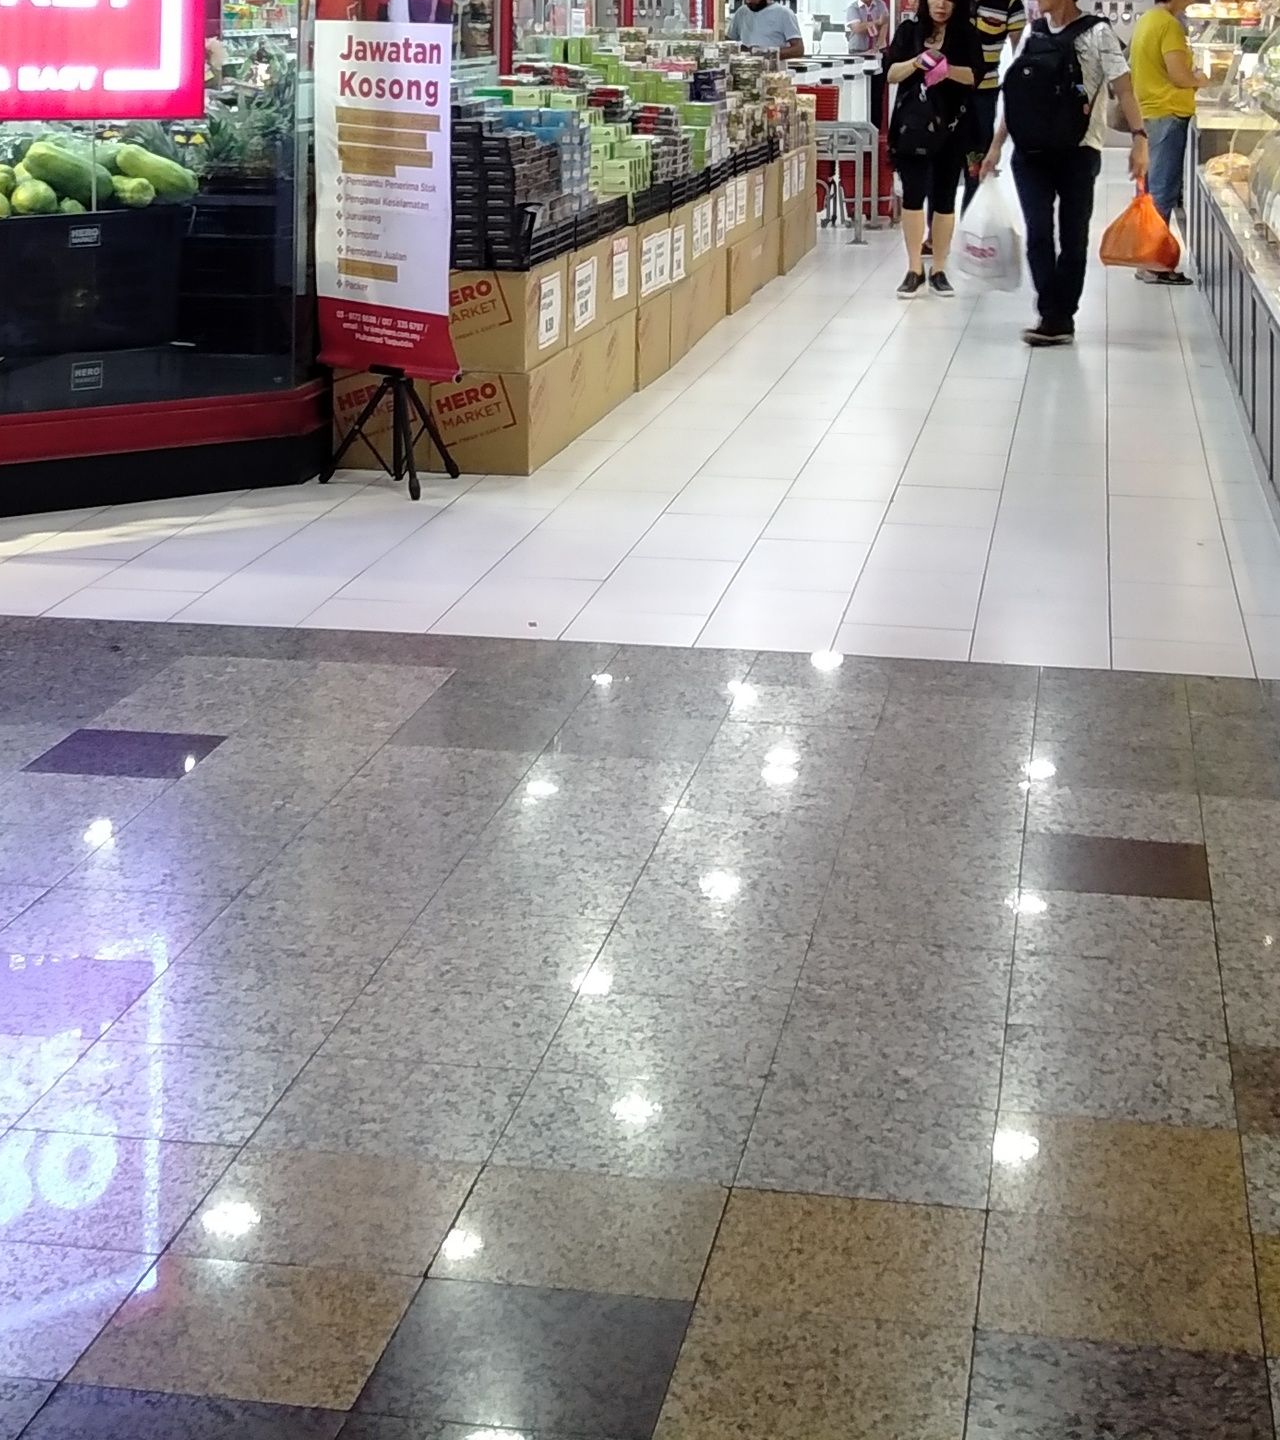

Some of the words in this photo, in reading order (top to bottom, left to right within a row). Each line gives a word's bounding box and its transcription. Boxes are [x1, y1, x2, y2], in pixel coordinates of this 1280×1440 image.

[339, 35, 442, 64] Jawatan
[339, 71, 440, 107] Kosong
[71, 228, 99, 237] HERO
[450, 280, 492, 307] ERO
[451, 299, 498, 324] ARKET
[74, 367, 101, 377] HERO
[435, 382, 498, 415] HERO
[442, 401, 503, 431] MARKET
